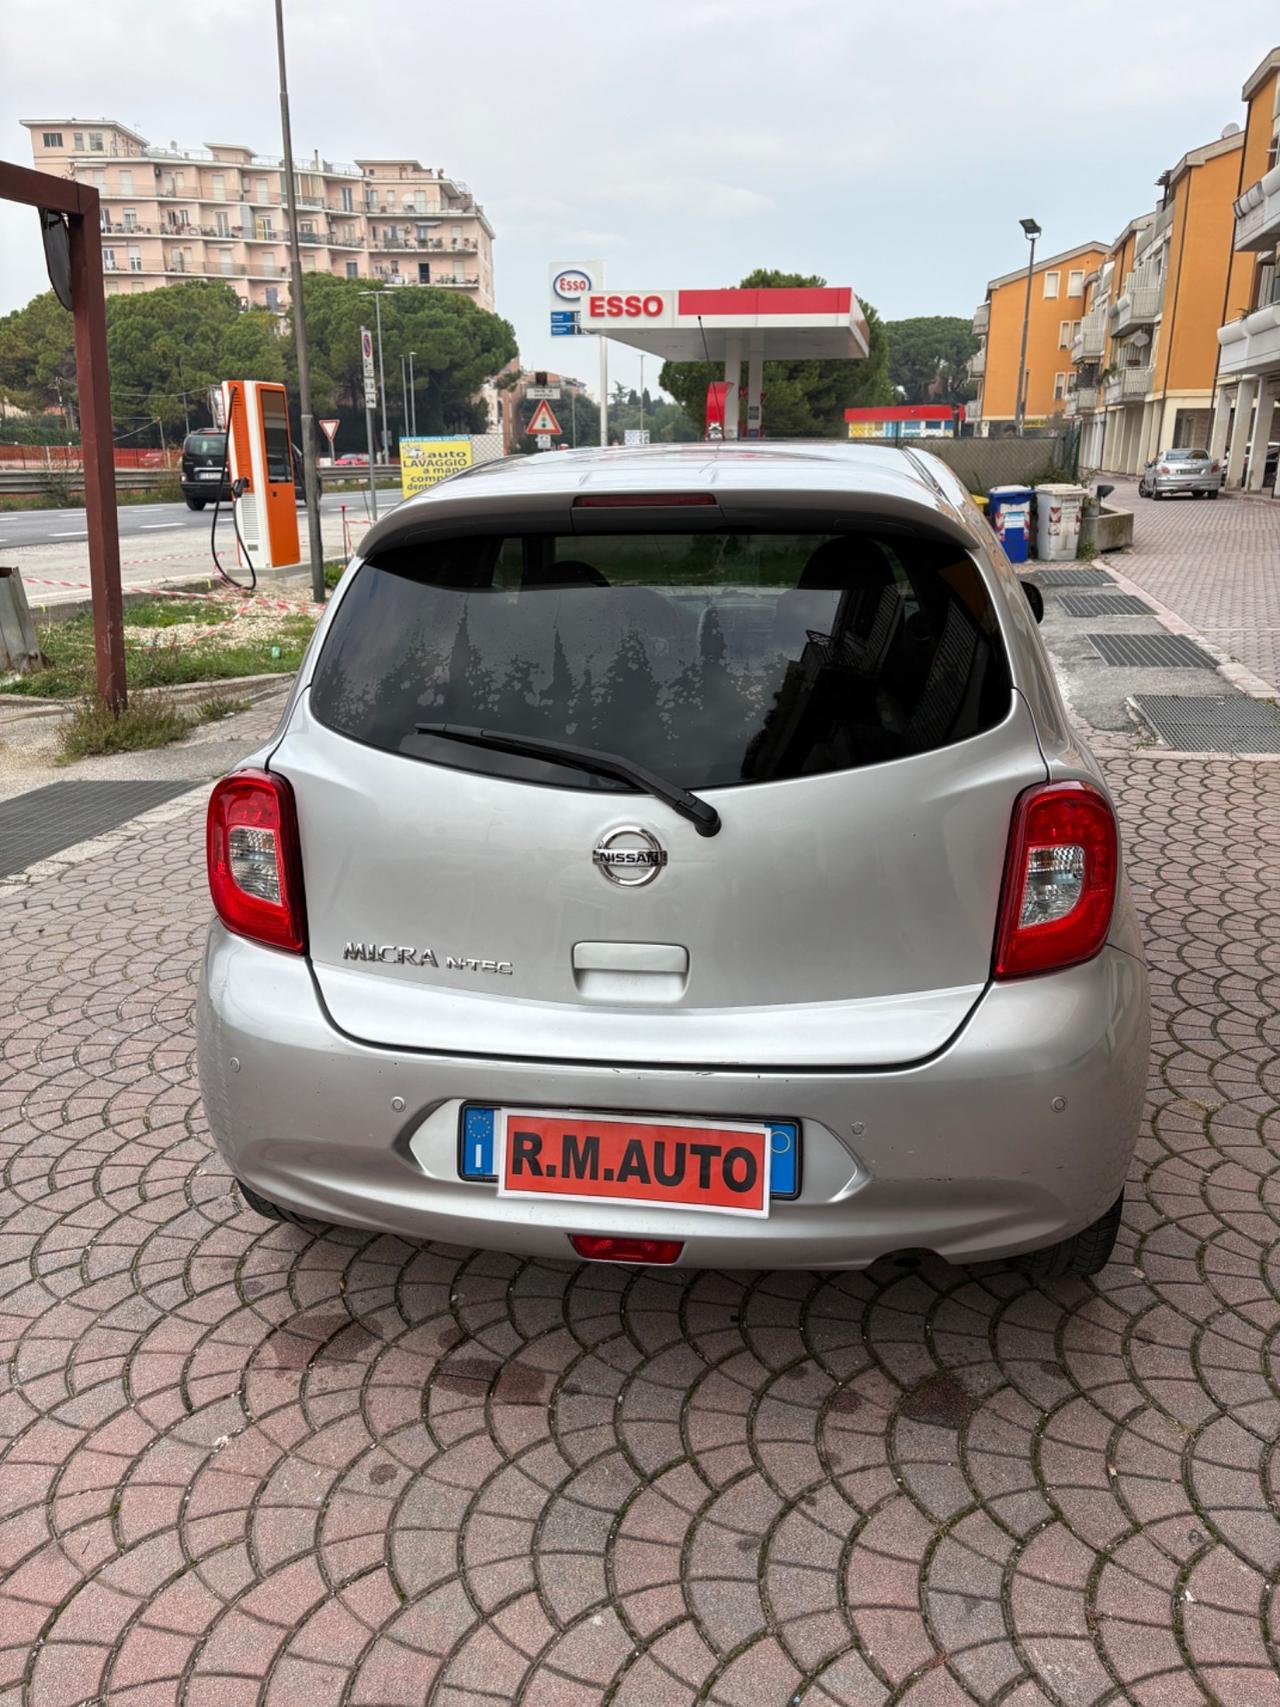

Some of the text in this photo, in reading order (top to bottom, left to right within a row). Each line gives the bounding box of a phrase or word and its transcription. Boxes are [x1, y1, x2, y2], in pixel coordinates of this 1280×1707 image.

[559, 277, 586, 291] Esso
[590, 295, 664, 317] ESSO
[403, 458, 467, 468] LAVAGGIO
[600, 852, 659, 864] NISSAN
[344, 942, 513, 975] MICRA N-TEC
[511, 1131, 758, 1192] R.M.AUTO
